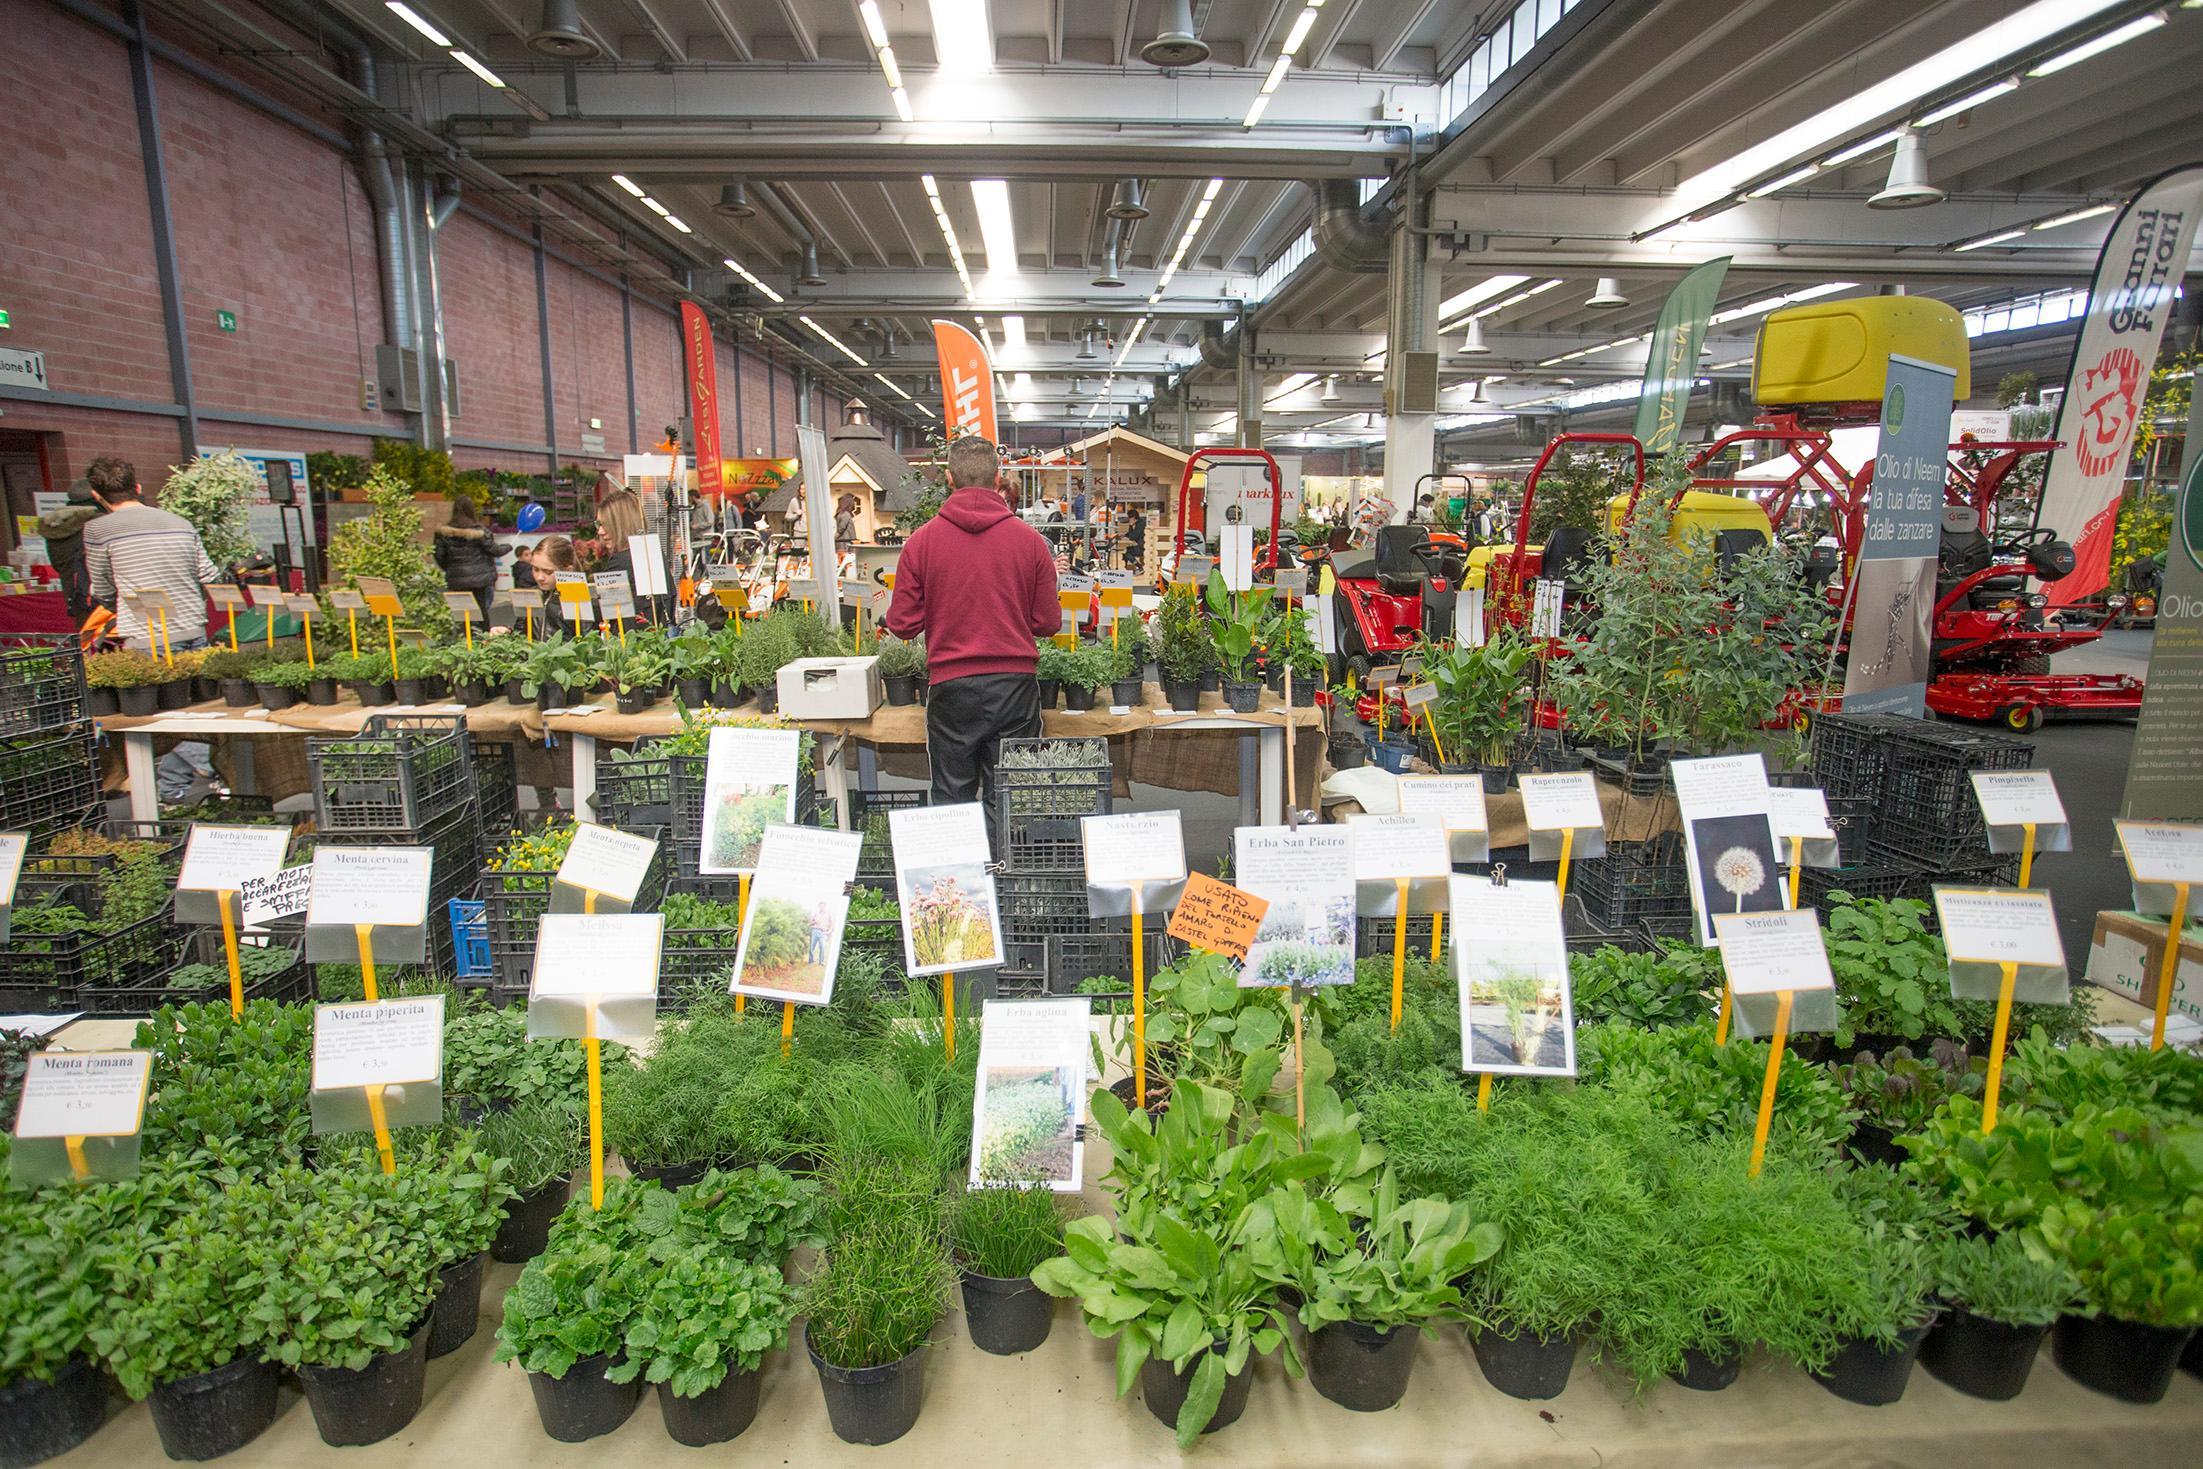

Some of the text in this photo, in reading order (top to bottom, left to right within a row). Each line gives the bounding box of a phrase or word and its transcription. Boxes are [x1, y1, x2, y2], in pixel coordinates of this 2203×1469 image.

[2109, 209, 2159, 334] Gianni
[2130, 211, 2184, 332] Ferrari
[25, 360, 33, 373] B
[1878, 453, 1940, 482] Olio di Neem
[1873, 486, 1932, 511] la tua difesa
[1869, 517, 1934, 541] dalle zanzare
[1692, 760, 1743, 771] Tarassaco
[1403, 781, 1437, 790] Cumino
[1454, 781, 1476, 790] prati
[904, 807, 970, 822] Erba cipollina
[1377, 815, 1416, 825] Achillea
[1106, 820, 1159, 830] Nasturzio
[209, 831, 269, 841] Hierba buena
[590, 830, 641, 852] Menta nepeta
[1249, 836, 1345, 848] Erba San Pietro
[335, 854, 408, 864] Menta cervina
[241, 877, 265, 892] PER
[1184, 891, 1214, 907] COME
[1205, 882, 1248, 907] USATO
[243, 902, 253, 913] E
[1181, 900, 1197, 913] DEL
[1179, 911, 1213, 929] AMARO
[1744, 916, 1787, 929] Stridoli
[332, 1004, 425, 1021] Menta piperita
[1007, 1008, 1032, 1017] Erba
[43, 1057, 134, 1070] Menta romana
